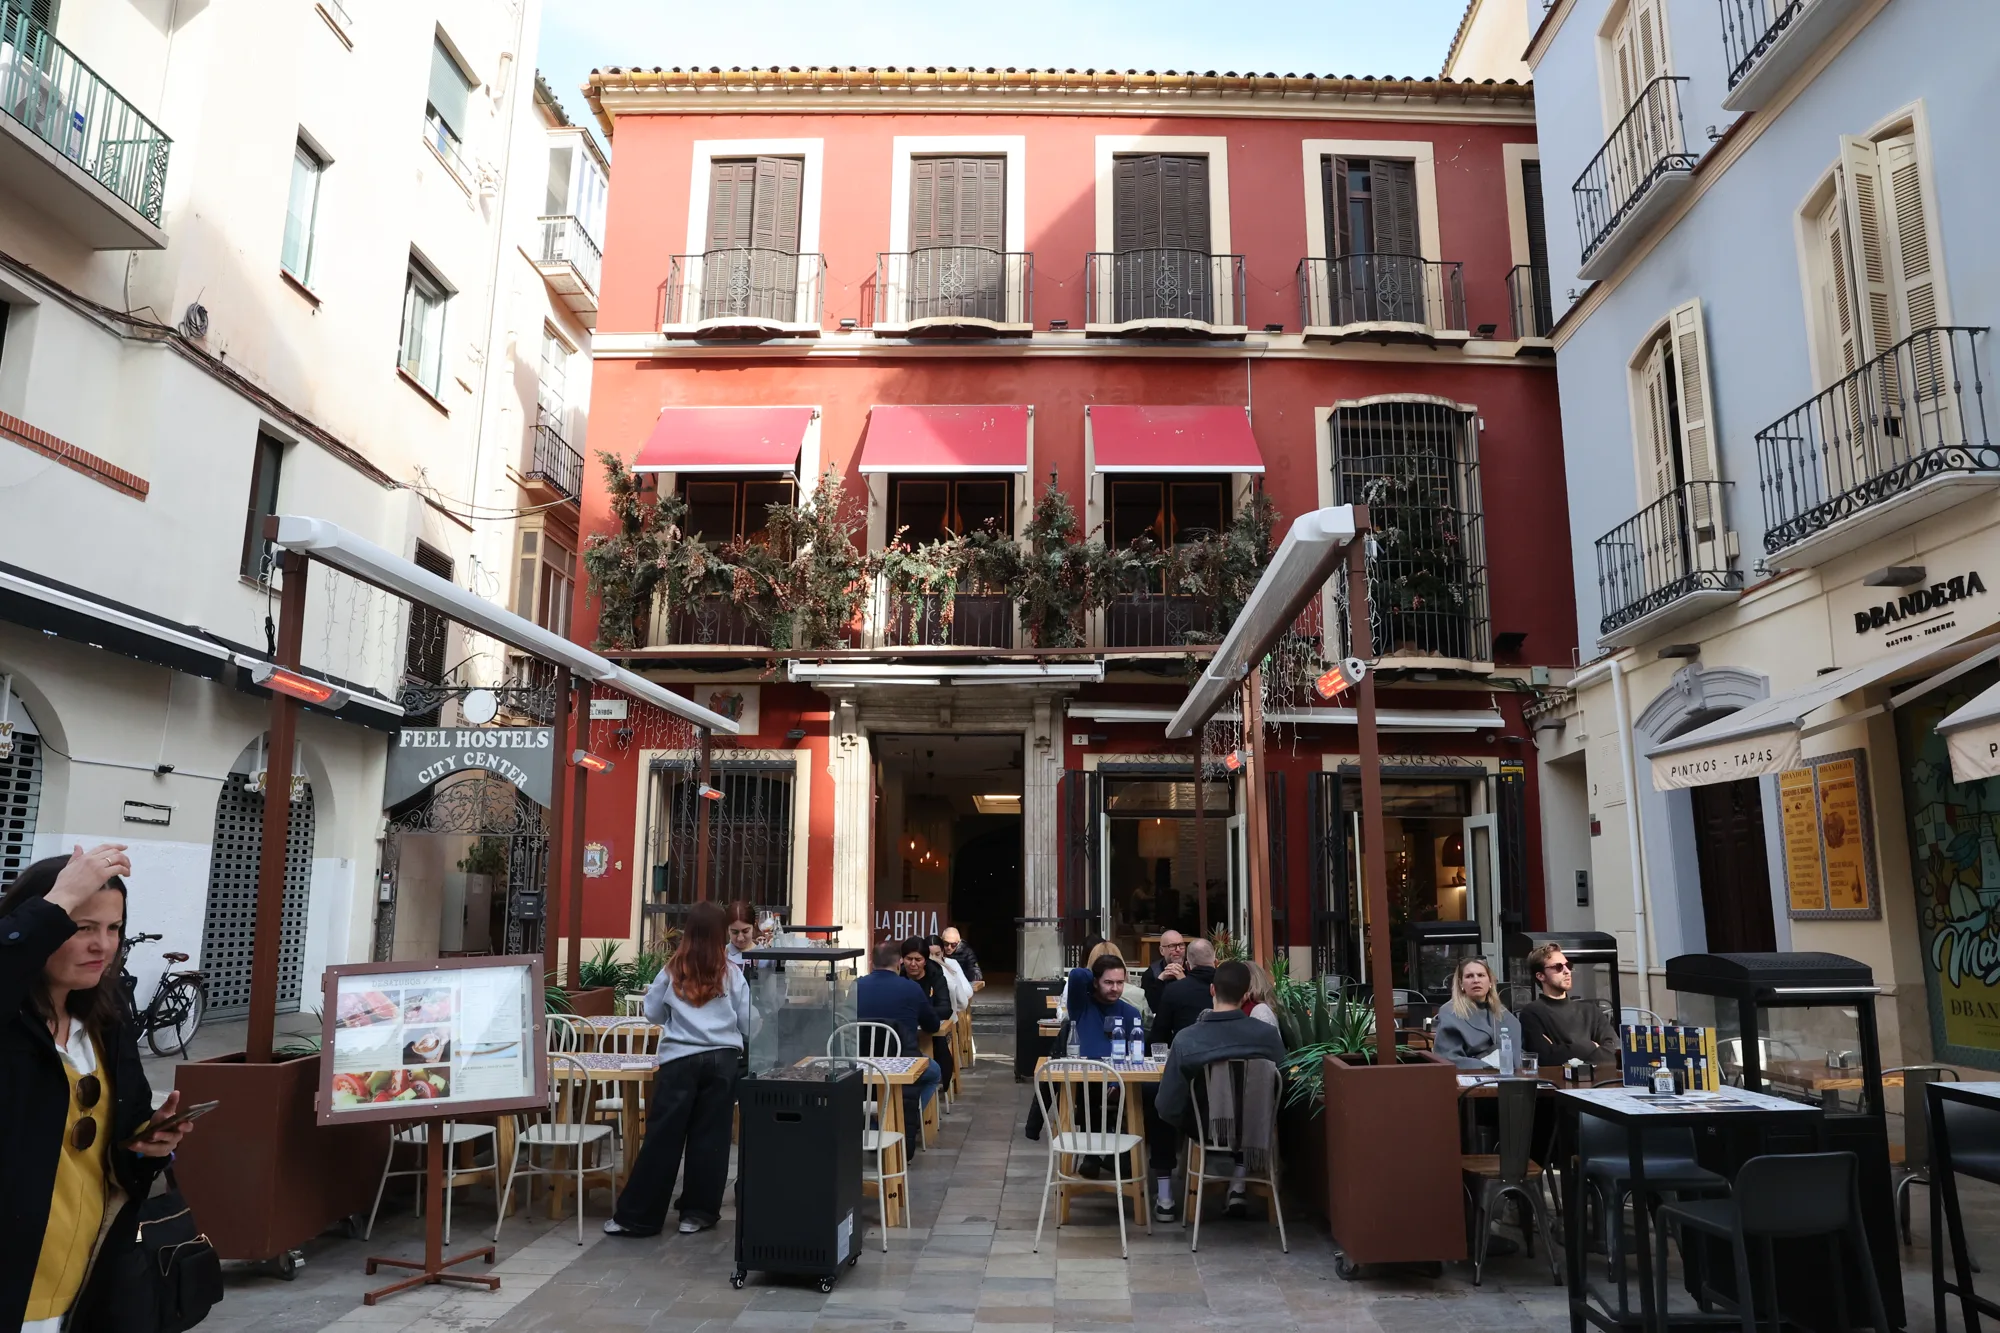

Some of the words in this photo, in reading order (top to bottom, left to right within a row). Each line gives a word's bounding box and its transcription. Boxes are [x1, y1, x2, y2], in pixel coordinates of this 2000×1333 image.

[1885, 634, 1913, 648] GASTRO
[1924, 620, 1956, 636] TABERNA
[399, 730, 450, 748] FEEL
[455, 730, 549, 749] HOSTELS
[418, 755, 456, 784] CITY
[463, 751, 528, 789] CENTER
[1671, 759, 1717, 778] PINTXOS
[1734, 749, 1773, 767] TAPAS
[875, 910, 891, 930] LA
[894, 910, 939, 941] BELLA
